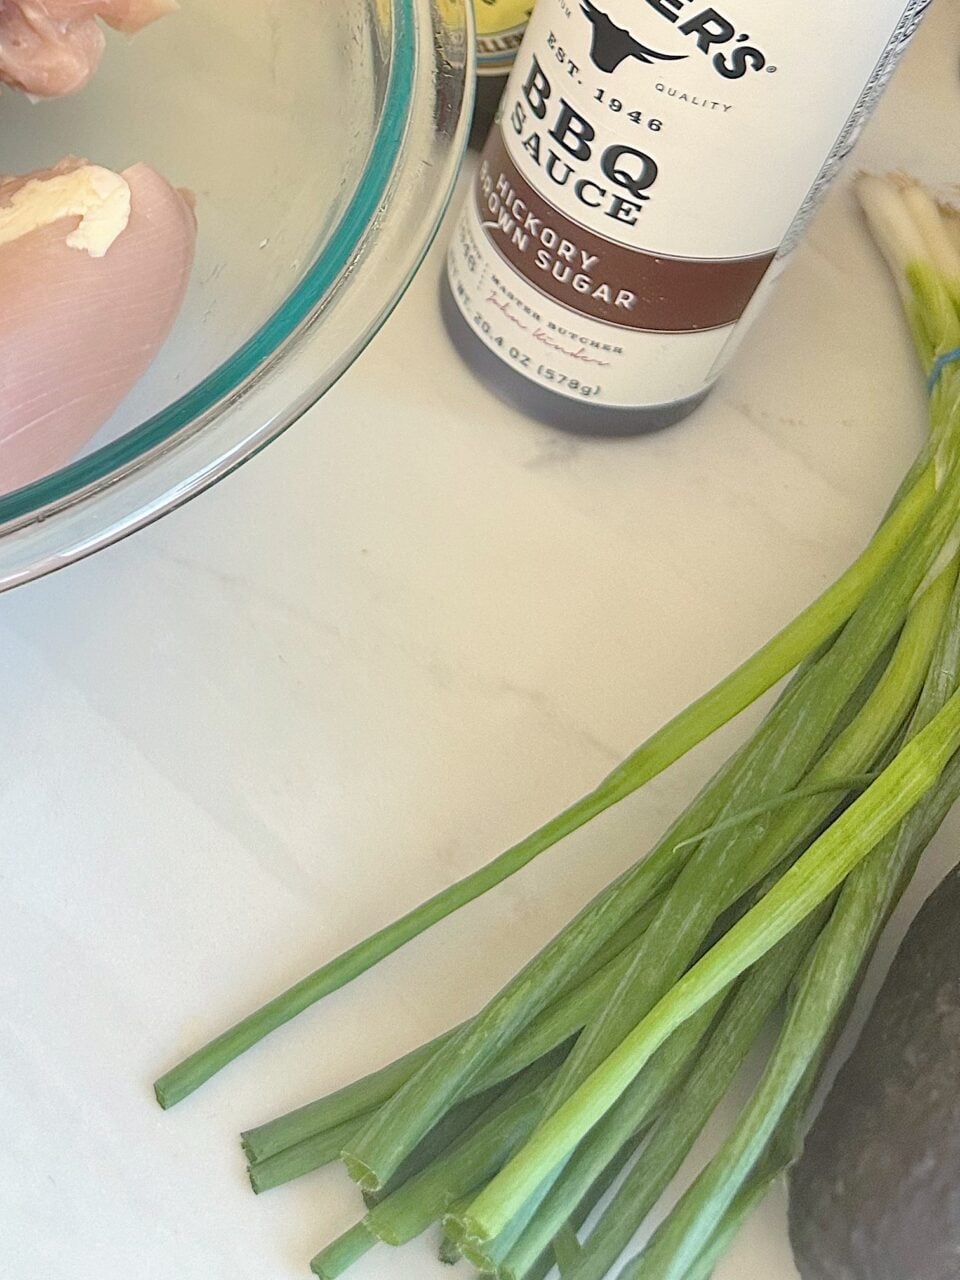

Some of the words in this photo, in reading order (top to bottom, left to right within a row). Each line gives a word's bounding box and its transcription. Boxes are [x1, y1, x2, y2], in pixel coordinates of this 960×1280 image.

[547, 30, 583, 85] EST.
[593, 87, 664, 133] 1946
[654, 82, 733, 113] QUALITY
[510, 101, 643, 227] SAUCE
[522, 53, 658, 201] BBQ
[496, 173, 600, 271] HICKORY
[534, 250, 638, 311] SUGAR
[546, 321, 625, 355] BUTCHER
[536, 363, 602, 397] (578g)
